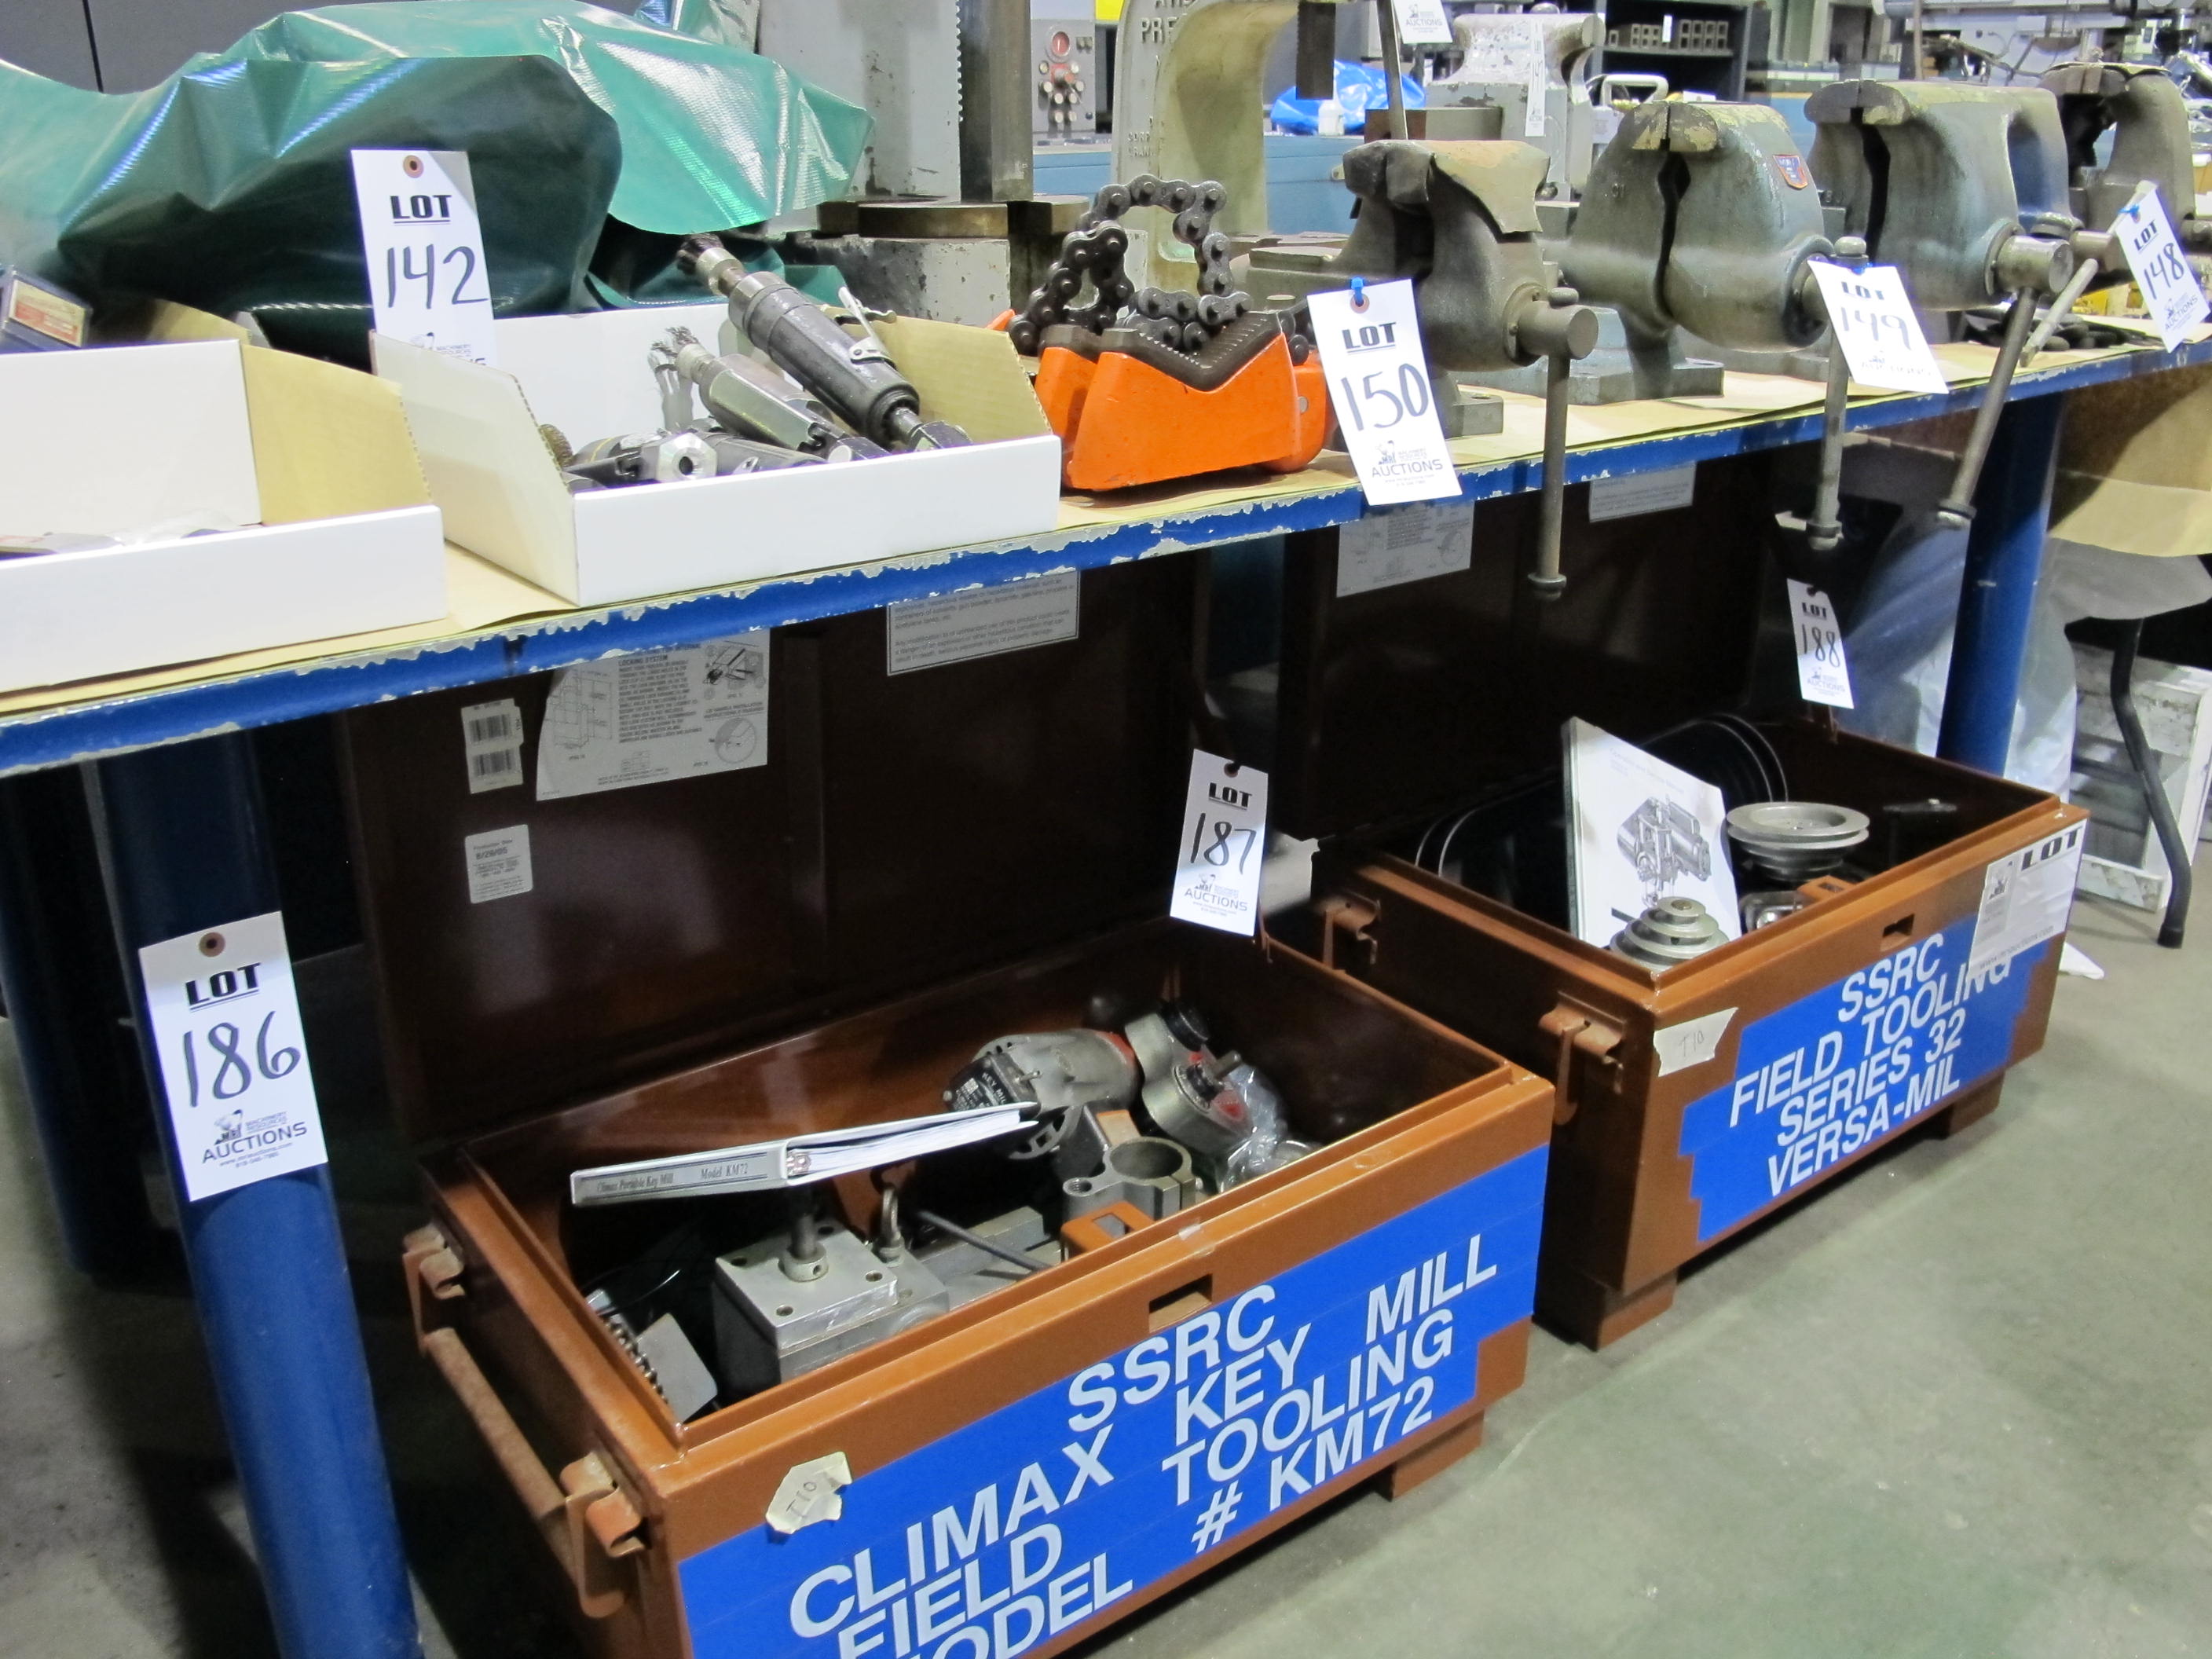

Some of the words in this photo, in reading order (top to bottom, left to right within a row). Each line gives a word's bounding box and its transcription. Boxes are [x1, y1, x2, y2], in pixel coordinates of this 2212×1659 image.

[1405, 18, 1443, 27] AUCTIONS
[390, 195, 452, 219] LOT
[2133, 220, 2159, 251] LOT
[387, 244, 490, 309] 142
[1841, 281, 1884, 300] LOT
[2144, 243, 2185, 300] 148
[1841, 307, 1911, 350] 149
[2165, 295, 2198, 330] AUCTIONS
[1342, 322, 1397, 350] LOT
[1341, 363, 1429, 431] 150
[1372, 459, 1443, 478] AUCTIONS
[1802, 602, 1827, 619] LOT
[1802, 623, 1840, 667] 188
[1807, 678, 1845, 692] AUCTIONS
[1208, 782, 1252, 808] LOT
[1190, 813, 1257, 875] 187
[2021, 826, 2082, 871] LOT
[1185, 888, 1247, 911] AUCTIONS
[185, 962, 261, 1006] LOT
[1838, 933, 1943, 1023] SSRC
[183, 1011, 301, 1108] 186
[982, 1071, 998, 1087] KEY
[1730, 1031, 1843, 1127] FIELD
[1777, 1035, 1911, 1147] SERIES
[1925, 1009, 1966, 1063] 32
[202, 1122, 308, 1163] AUCTIONS
[1767, 1054, 1961, 1197] VERSA-MIL
[619, 1176, 645, 1192] Portable
[645, 1174, 658, 1189] Key
[701, 1167, 723, 1180] Model
[726, 1163, 749, 1177] KM72
[1068, 1284, 1276, 1432] SSRC
[789, 1424, 1115, 1638] CLIMAX
[1176, 1323, 1312, 1446] KEY
[1366, 1234, 1497, 1345] MILL
[838, 1523, 1062, 1659] FIELD
[1162, 1309, 1453, 1506] TOOLING
[1192, 1481, 1243, 1553] #
[1270, 1375, 1434, 1511] KM72
